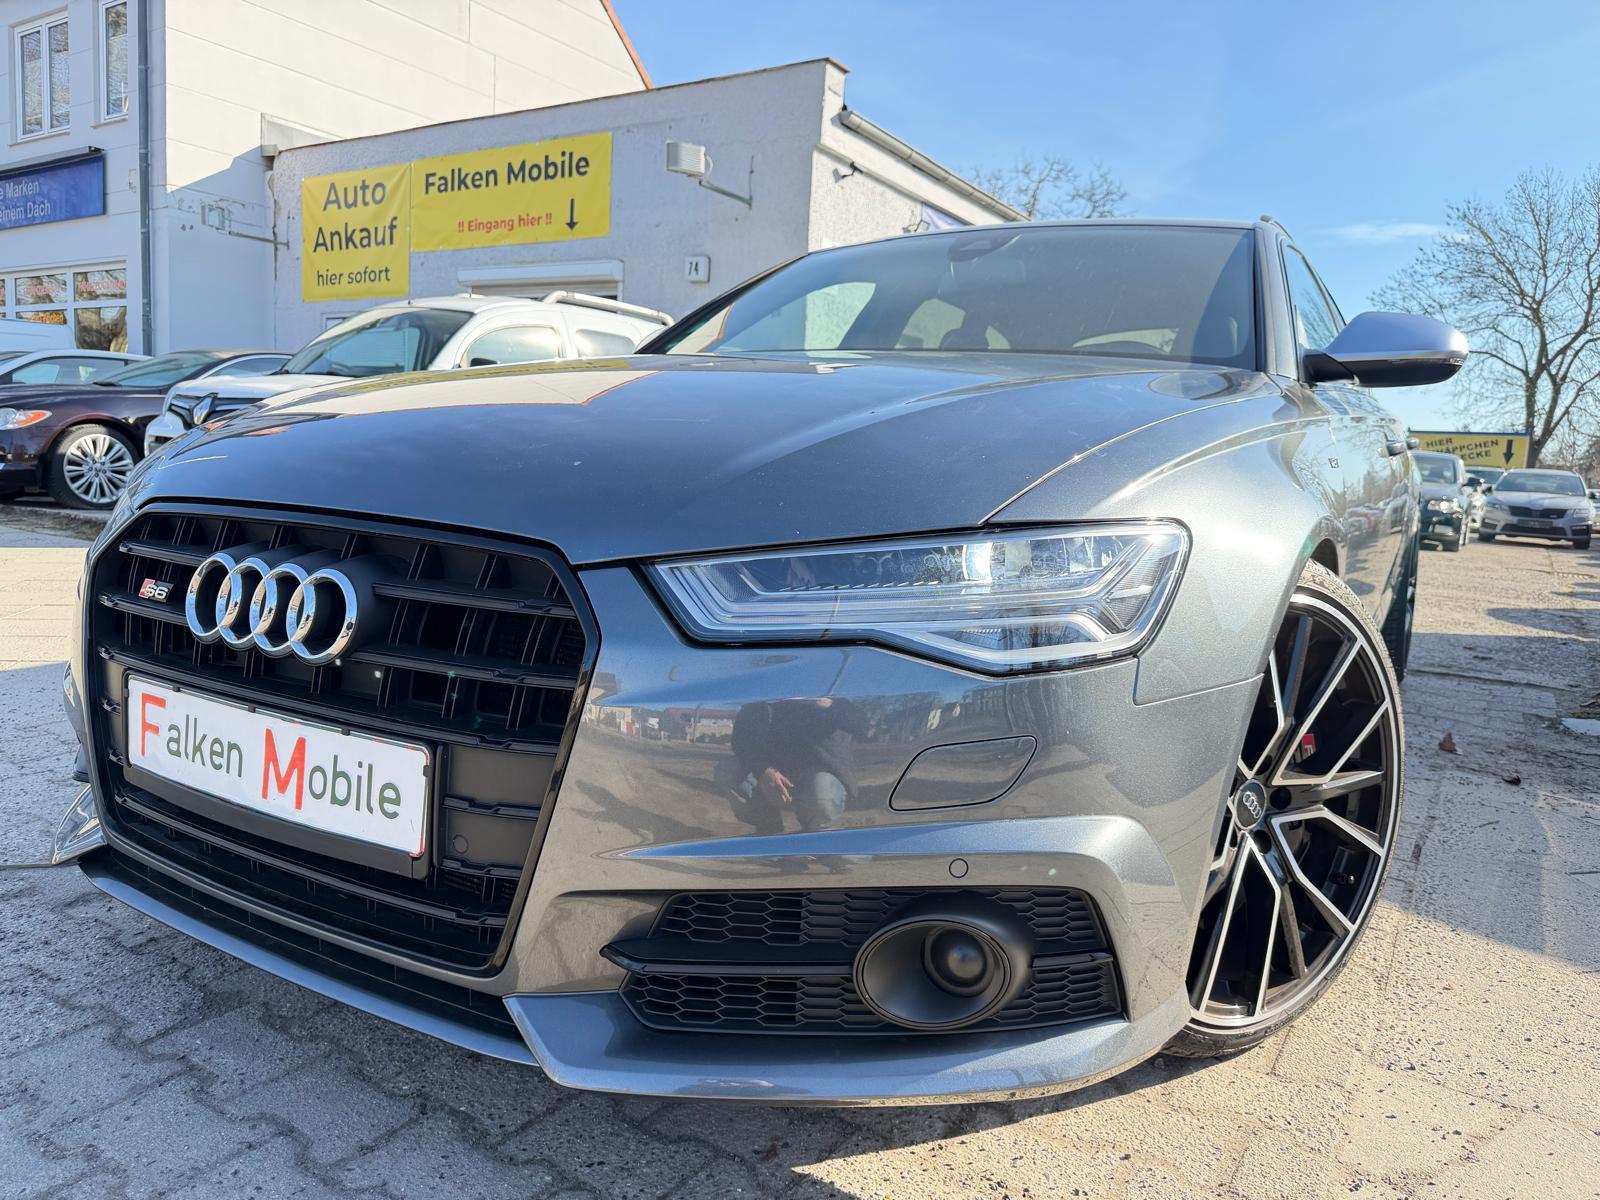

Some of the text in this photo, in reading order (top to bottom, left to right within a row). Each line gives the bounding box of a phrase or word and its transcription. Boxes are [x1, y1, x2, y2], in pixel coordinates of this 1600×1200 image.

[424, 150, 590, 195] Falken Mobile
[5, 180, 39, 199] Marken
[322, 179, 387, 212] Auto
[26, 200, 51, 218] Dach
[468, 216, 515, 234] Eingang
[518, 213, 543, 228] hier
[313, 216, 398, 253] Ankauf
[317, 266, 391, 287] hier sofort
[688, 261, 699, 276] 74
[1425, 437, 1453, 448] HIER
[145, 583, 168, 599] S6
[141, 692, 401, 820] Falken Mobile
